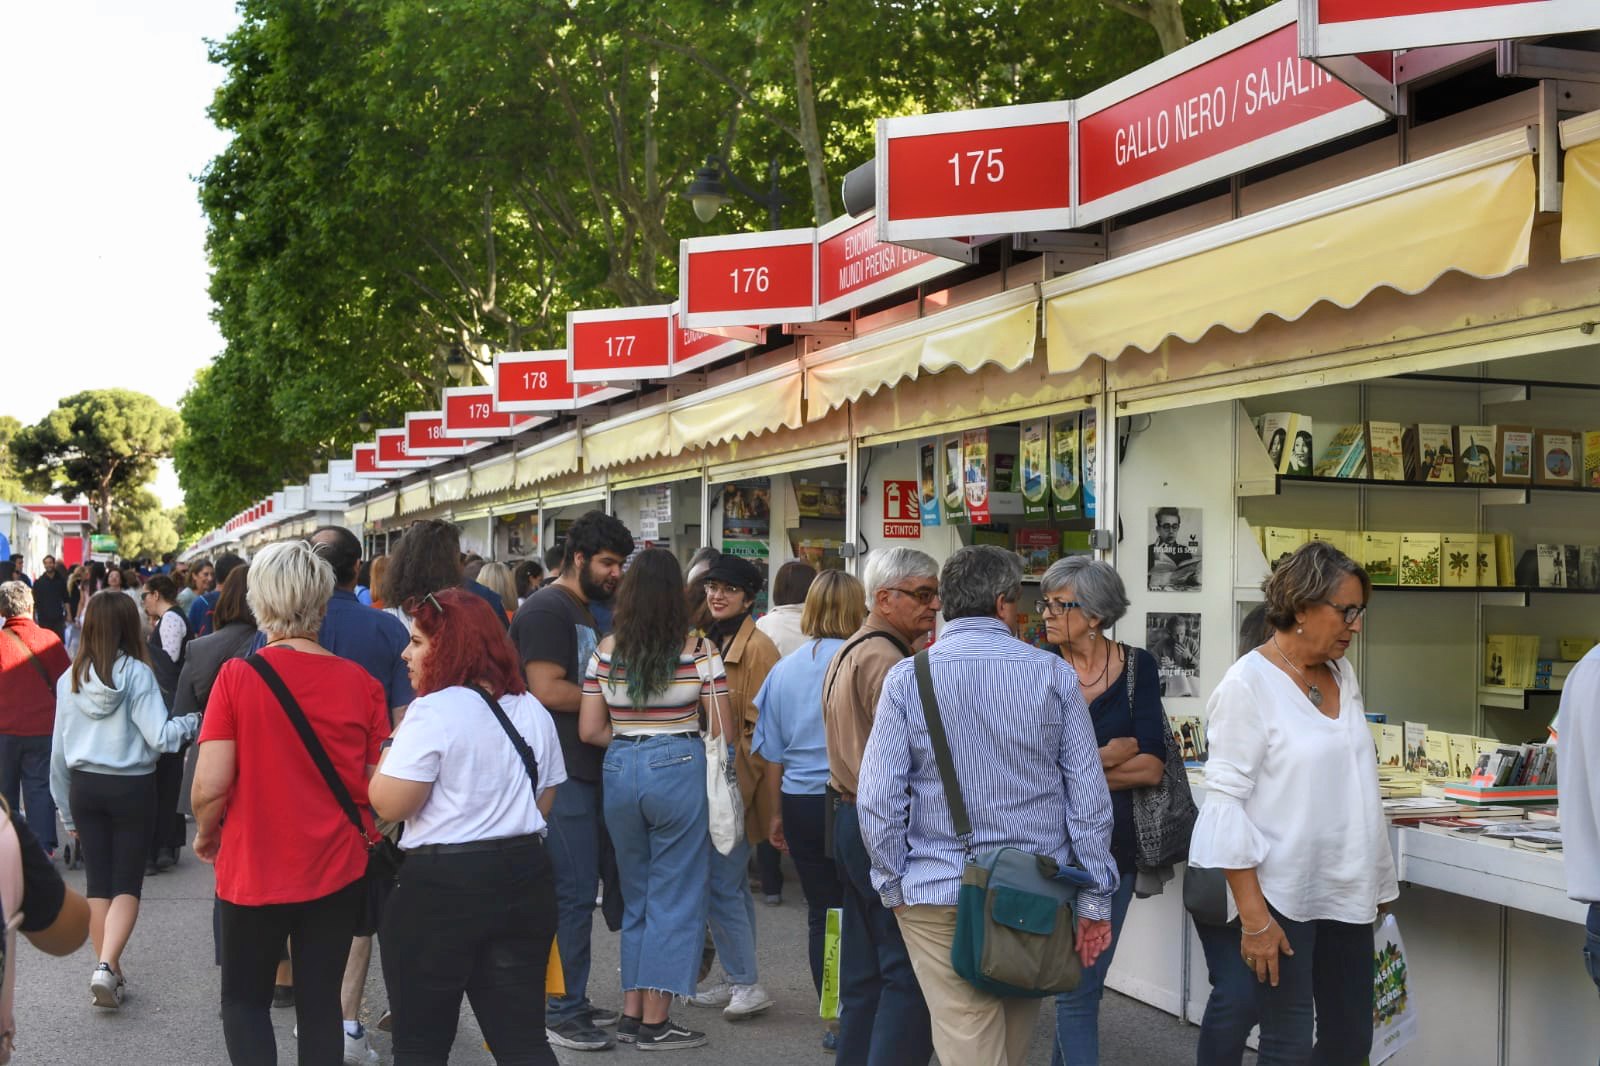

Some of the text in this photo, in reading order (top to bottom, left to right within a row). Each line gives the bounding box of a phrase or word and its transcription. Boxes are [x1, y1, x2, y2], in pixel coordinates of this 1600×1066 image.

[1114, 109, 1169, 166] GALLO
[1174, 85, 1228, 144] NERO
[1231, 81, 1240, 123] /
[947, 148, 1005, 187] 175
[729, 266, 770, 293] 176
[839, 258, 865, 291] MUNDI
[865, 246, 896, 280] PRENSA
[604, 335, 636, 357] 177
[522, 371, 548, 390] 178
[468, 403, 490, 419] 179
[396, 441, 406, 453] 18
[884, 524, 919, 536] EXTINTOR
